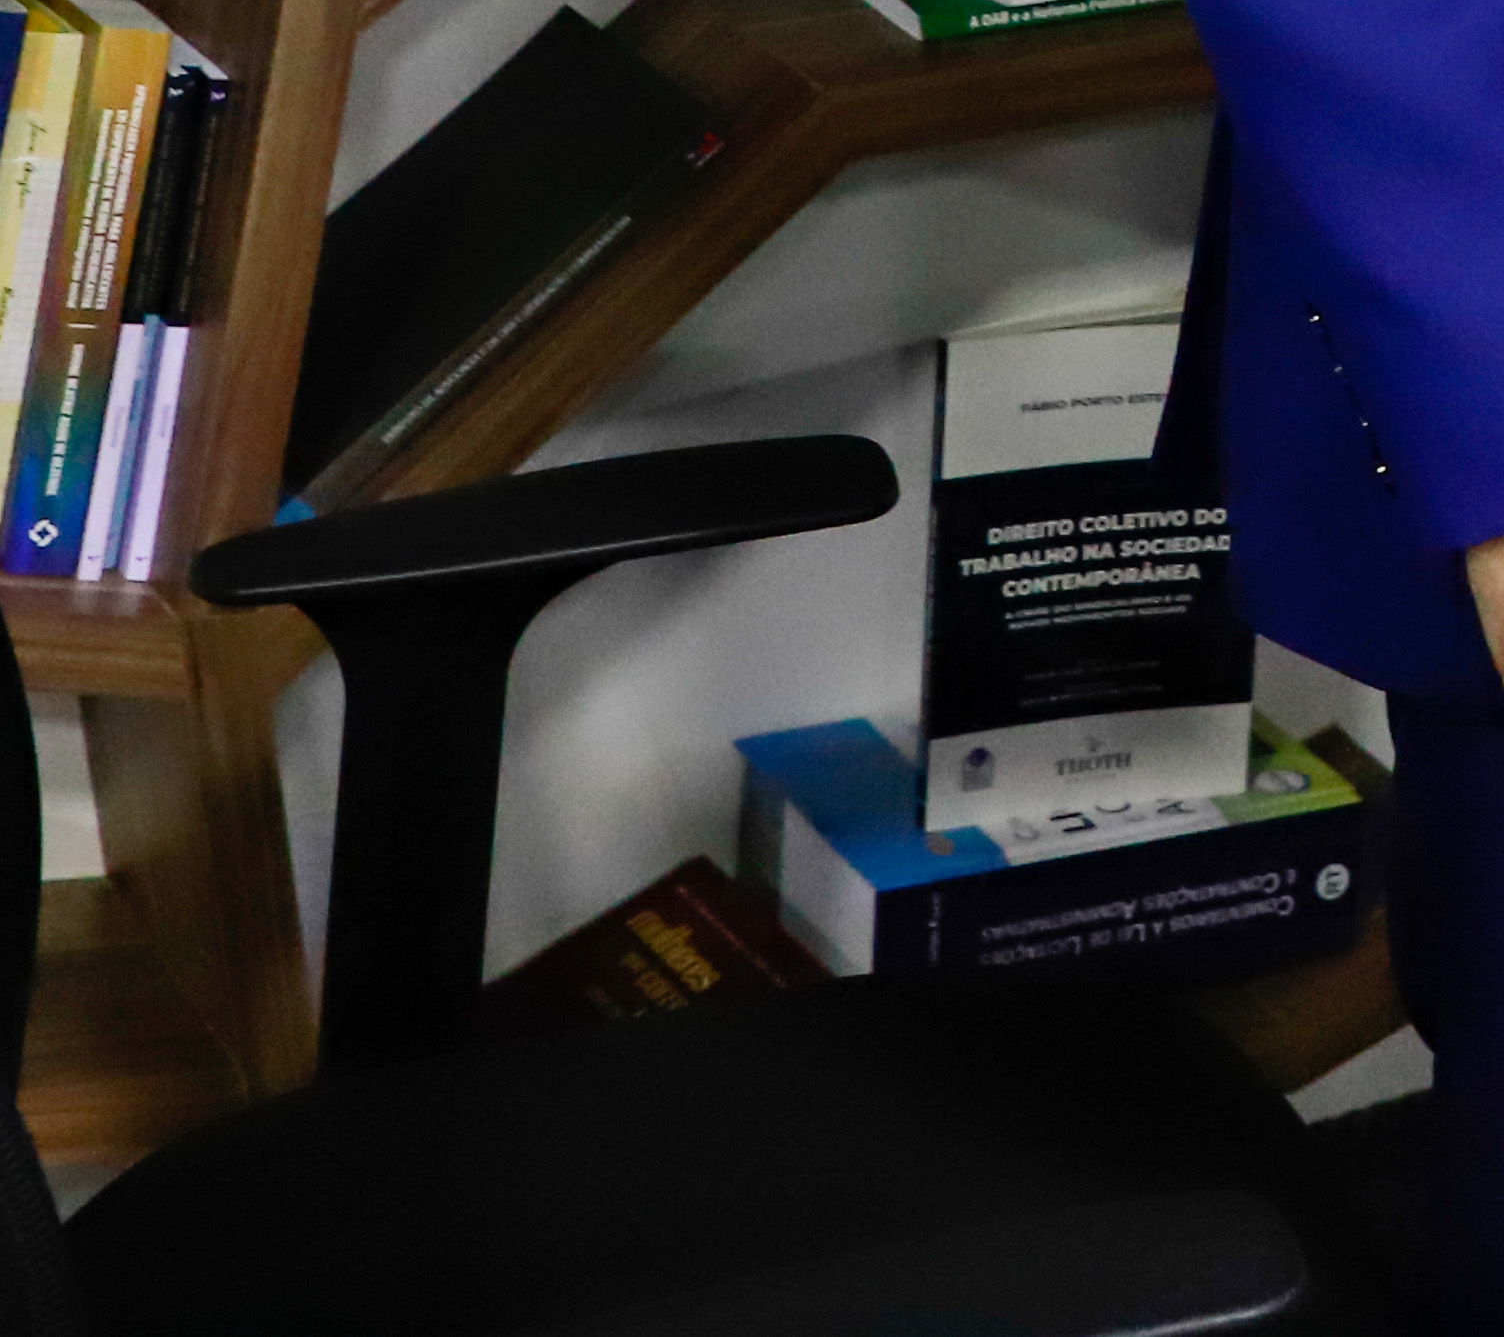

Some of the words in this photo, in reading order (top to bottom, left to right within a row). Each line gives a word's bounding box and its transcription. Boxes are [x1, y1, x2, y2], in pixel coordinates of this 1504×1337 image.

[986, 519, 1075, 546] DIREITO
[1078, 510, 1189, 534] COLETIVO
[1193, 507, 1228, 526] DO
[958, 548, 1079, 577] TRABALHO
[1082, 544, 1116, 561] NA
[1001, 563, 1201, 598] CONTEMPORÂNEA
